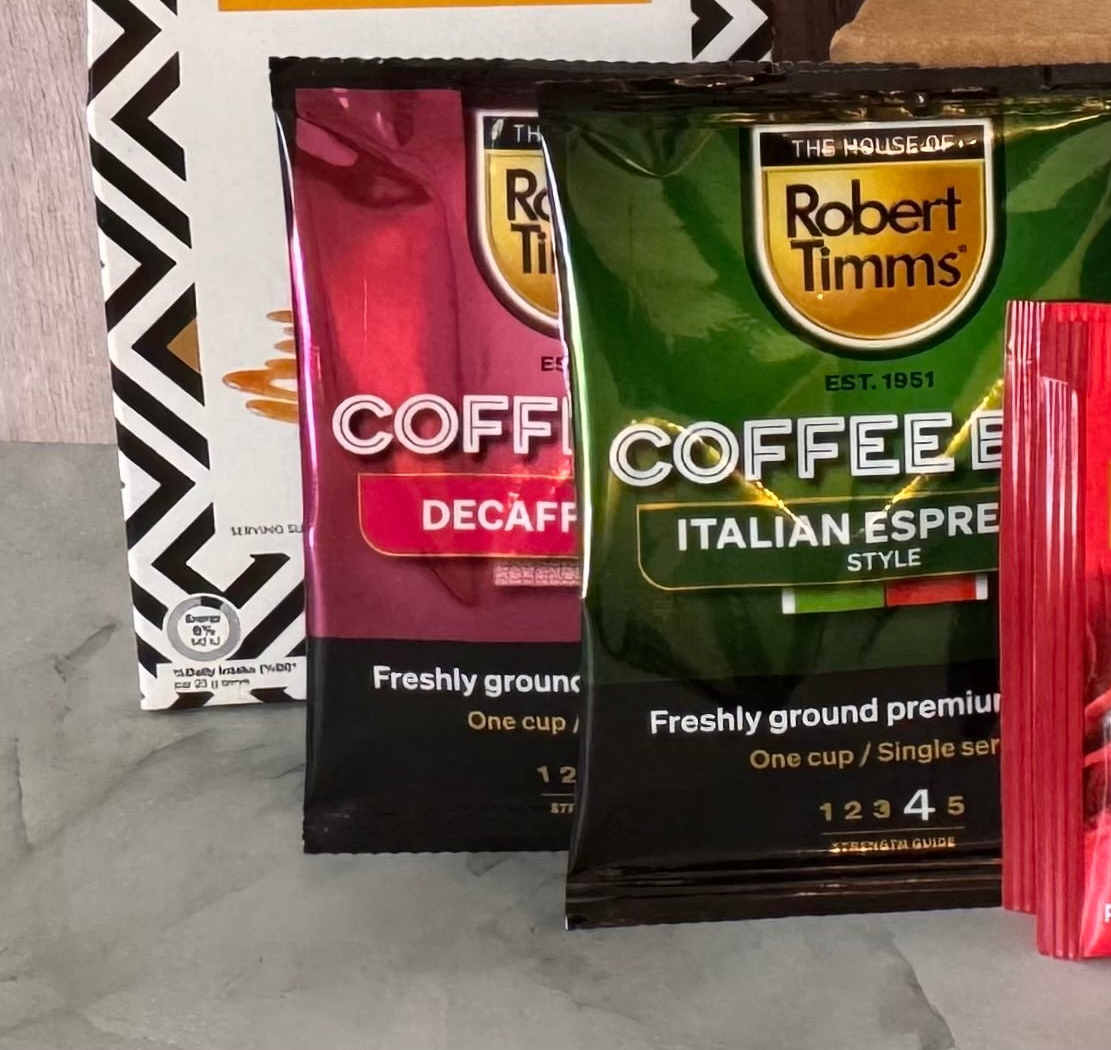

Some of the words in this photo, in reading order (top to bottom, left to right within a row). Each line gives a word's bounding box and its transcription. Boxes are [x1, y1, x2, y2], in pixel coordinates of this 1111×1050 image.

[792, 139, 836, 159] THE
[843, 135, 918, 156] HOUSE
[786, 179, 962, 239] Robert
[825, 373, 878, 391] EST.
[884, 371, 935, 389] 1951
[332, 394, 572, 455] COFF
[609, 412, 955, 487] COFFEE
[677, 513, 850, 551] ITALIAN
[847, 547, 922, 572] STYLE
[373, 665, 478, 696] Freshly
[467, 710, 516, 730] One
[522, 715, 566, 734] cup
[650, 706, 762, 735] Freshly
[769, 697, 878, 735] ground
[750, 749, 801, 769] One
[808, 749, 854, 769] cup
[877, 738, 955, 764] Single
[536, 765, 549, 783] 1
[559, 766, 576, 783] 2
[819, 802, 832, 821] 1
[844, 801, 863, 820] 2
[873, 799, 891, 818] 3
[903, 789, 936, 821] 4
[947, 796, 965, 815] 5
[912, 835, 956, 849] GUIDE
